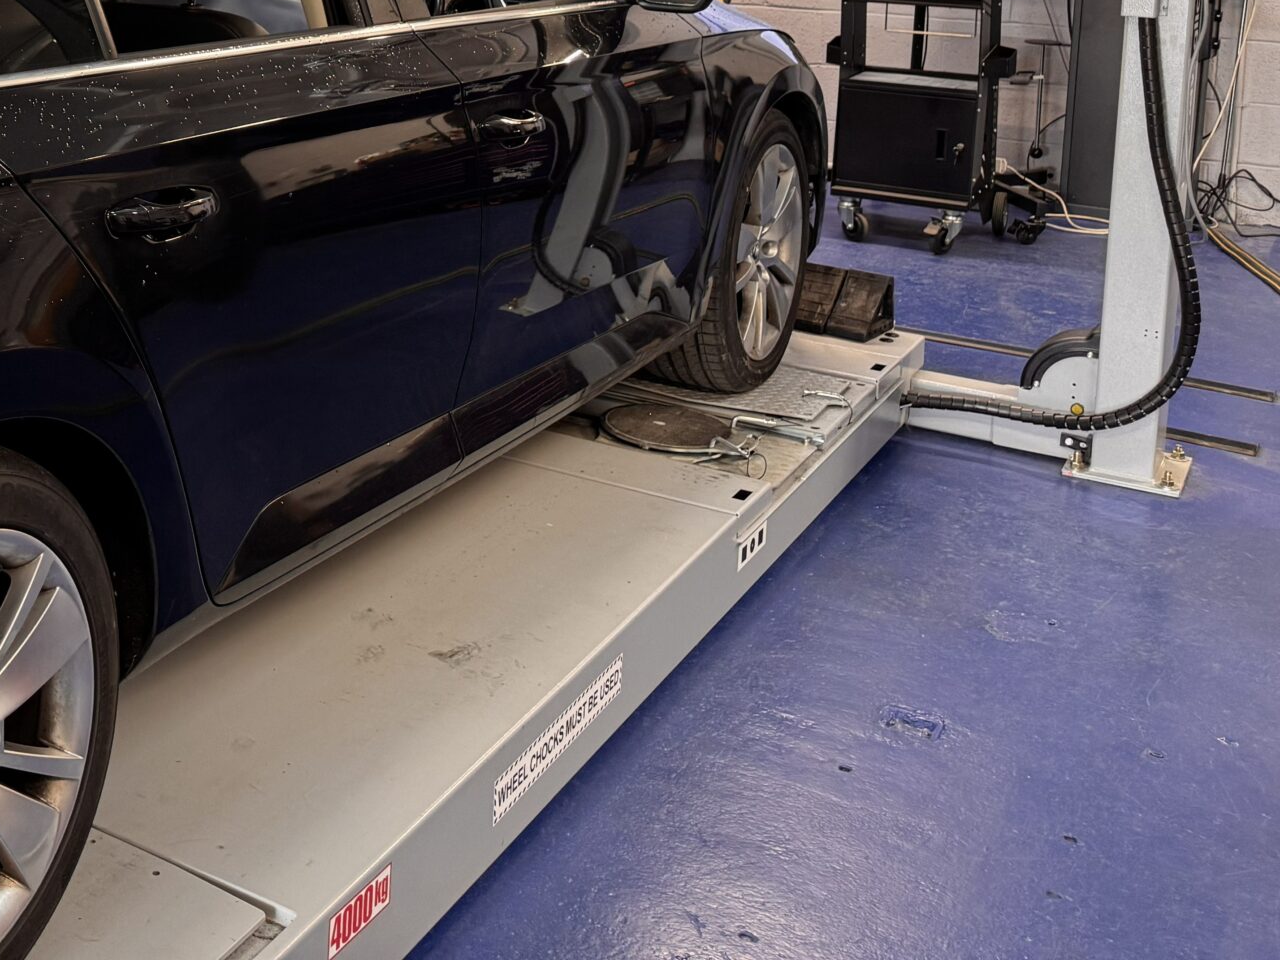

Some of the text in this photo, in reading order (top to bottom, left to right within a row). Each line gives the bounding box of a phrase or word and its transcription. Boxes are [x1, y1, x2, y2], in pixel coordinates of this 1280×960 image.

[498, 669, 619, 807] WHEEL CHOCKS MUST BE USED
[331, 874, 389, 951] 4000 kg
